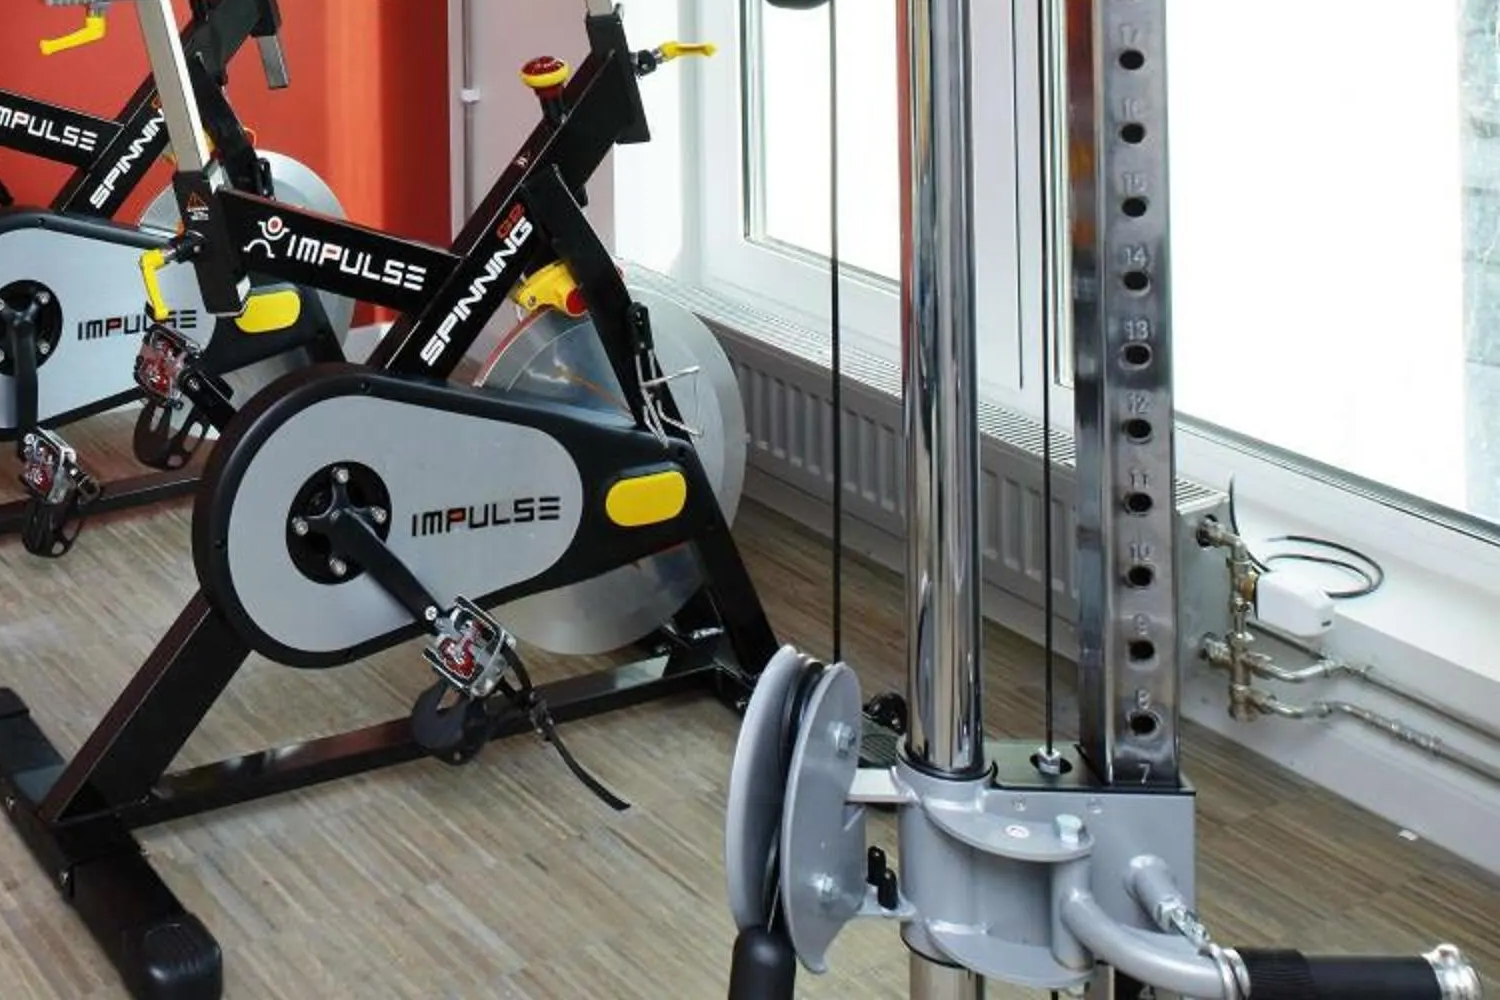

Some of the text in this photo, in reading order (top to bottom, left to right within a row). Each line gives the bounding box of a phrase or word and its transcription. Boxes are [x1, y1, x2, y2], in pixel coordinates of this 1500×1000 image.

[89, 108, 165, 209] SPINNIN
[1124, 172, 1148, 193] 15
[286, 234, 427, 291] IMPULSE
[1124, 247, 1148, 266] 14
[420, 216, 533, 367] SPINNING
[1124, 320, 1150, 340] 13
[1127, 393, 1151, 414] 12
[411, 496, 560, 537] IMPULSE
[1137, 763, 1151, 784] 7
